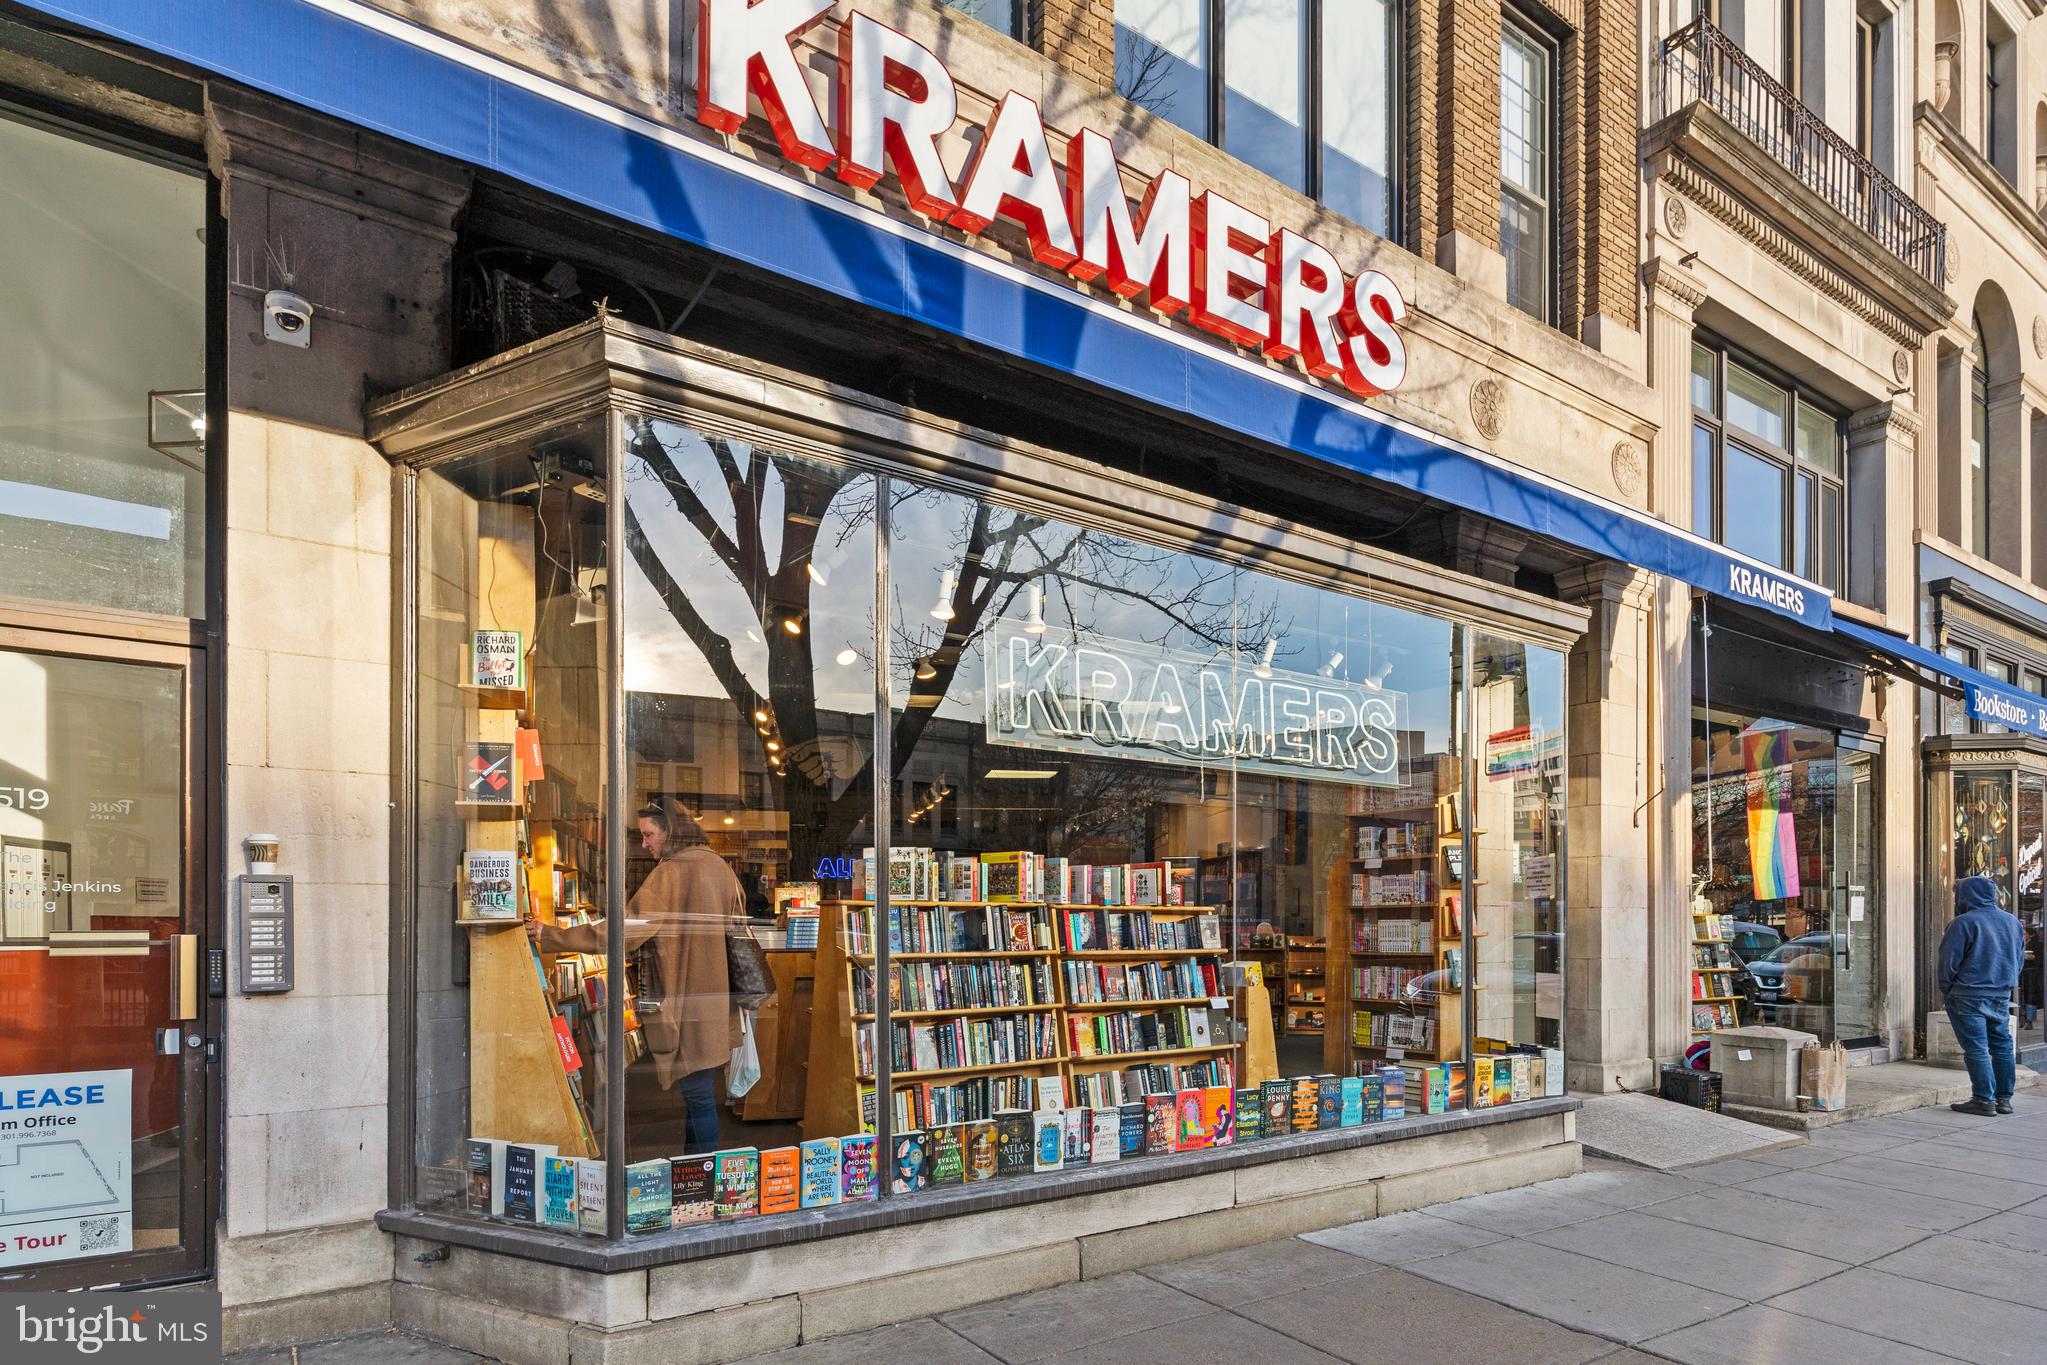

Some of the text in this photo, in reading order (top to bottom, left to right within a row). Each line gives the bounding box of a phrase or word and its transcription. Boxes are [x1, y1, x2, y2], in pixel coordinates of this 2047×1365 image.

[698, 0, 1407, 397] KRAMERS
[1730, 563, 1805, 616] KRAMERS
[477, 645, 515, 653] OSMAN
[1009, 636, 1398, 774] KRAMERS
[1974, 689, 2028, 725] Bookstore
[470, 860, 510, 868] DANGEROUS
[470, 869, 510, 878] BUSINESS
[52, 880, 121, 893] Jenkins
[471, 894, 507, 906] SMILEY
[1320, 1085, 1340, 1094] KING
[0, 1085, 105, 1111] LEASE
[25, 1115, 77, 1128] Office
[1, 1130, 57, 1140] 301.996.7368
[813, 1147, 831, 1156] SALLY
[1003, 1143, 1030, 1154] ATLAS
[806, 1156, 837, 1166] ROONEY
[1008, 1153, 1025, 1165] SIX
[509, 1167, 533, 1175] JANUARY
[717, 1171, 755, 1180] TUESDAYS
[545, 1172, 570, 1185] STARTS
[580, 1181, 604, 1192] SILENT
[727, 1182, 755, 1191] WINTER
[811, 1185, 832, 1193] WHERE
[510, 1188, 532, 1197] REPORT
[545, 1186, 573, 1199] WITH US
[579, 1195, 606, 1206] PATIENT
[718, 1201, 753, 1211] LILY KING
[545, 1206, 574, 1220] HOOVER
[14, 1232, 67, 1250] Tour
